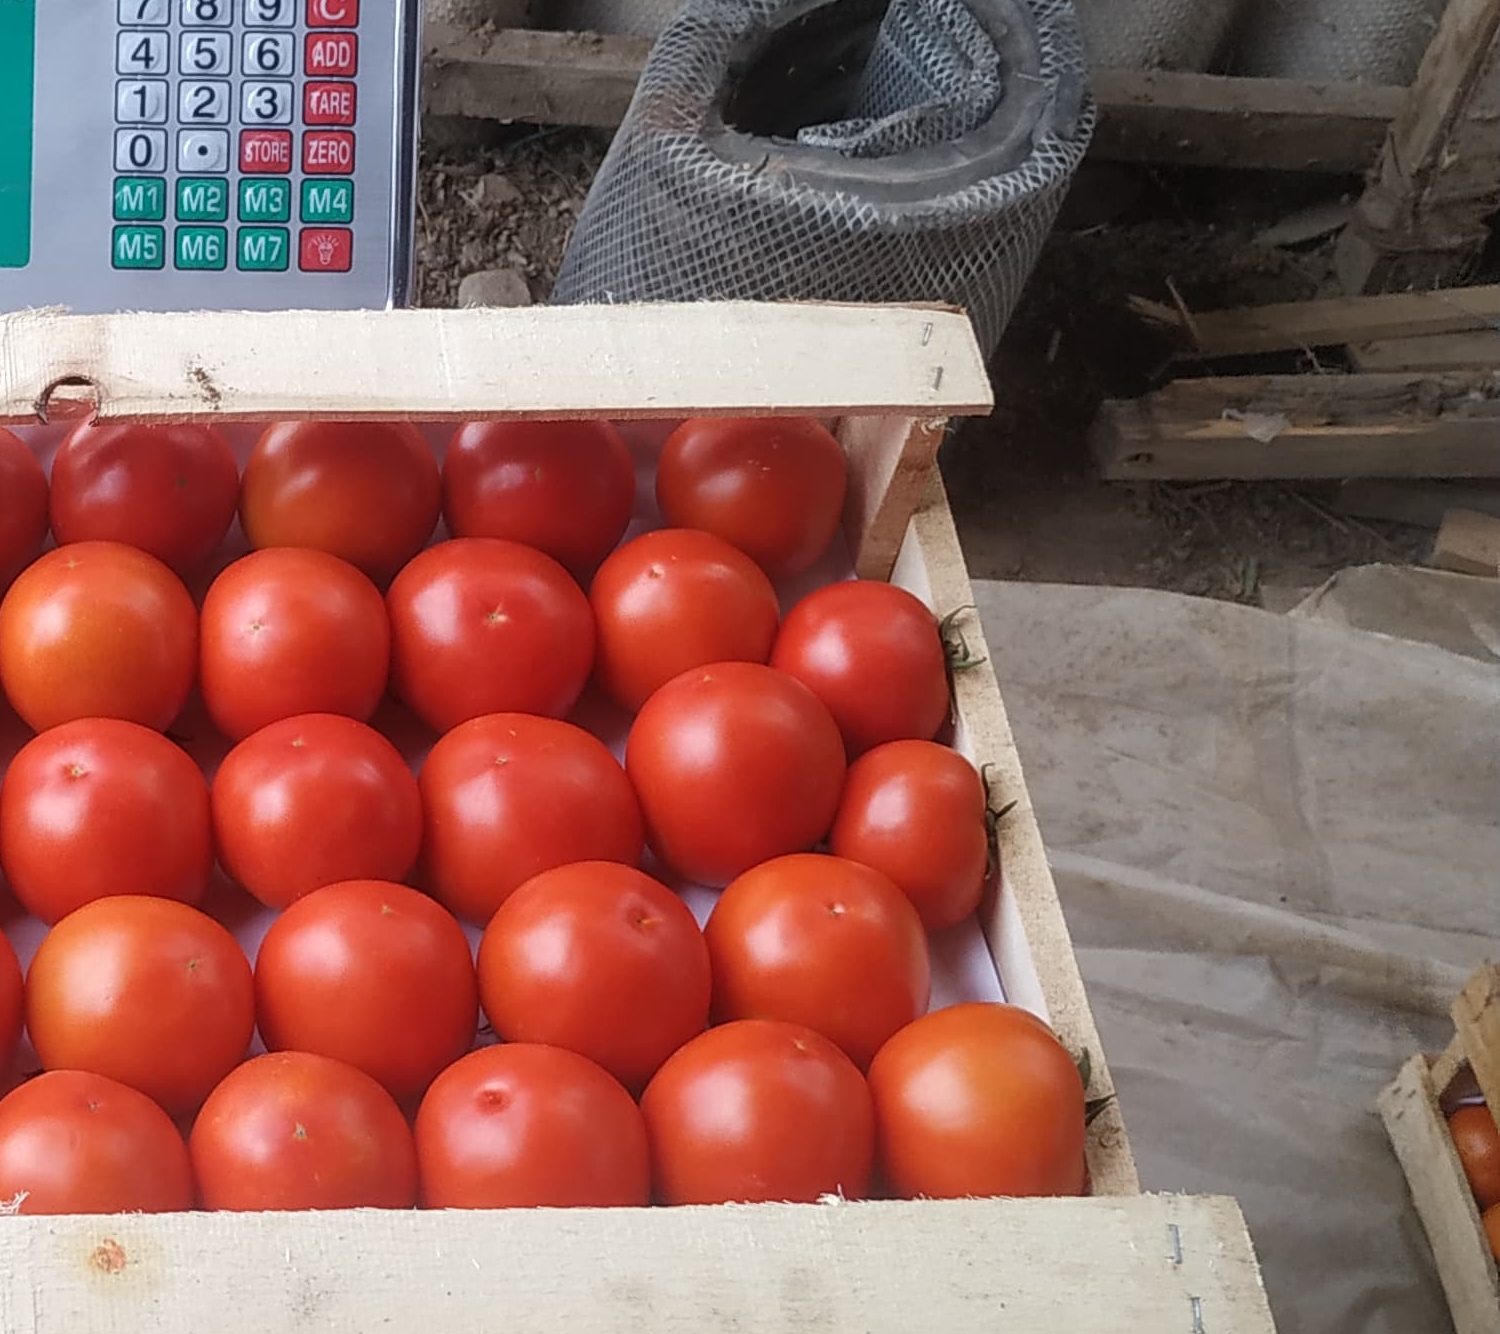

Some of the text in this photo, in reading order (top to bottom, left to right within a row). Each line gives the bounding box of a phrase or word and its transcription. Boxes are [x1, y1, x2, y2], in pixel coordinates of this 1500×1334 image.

[131, 38, 154, 69] 4
[194, 38, 216, 70] 5
[257, 38, 280, 70] 6
[312, 45, 350, 67] ADD
[133, 87, 146, 118] 1
[193, 86, 215, 118] 2
[255, 87, 278, 119] 3
[310, 92, 350, 115] TARE
[130, 135, 152, 167] 0
[244, 142, 288, 164] STORE
[308, 142, 351, 164] ZERO
[122, 186, 158, 211] M1
[183, 187, 221, 212] M2
[245, 188, 283, 213] M3
[309, 190, 347, 214] M4
[120, 234, 157, 260] M5
[182, 235, 219, 261] M6
[244, 236, 281, 261] M7
